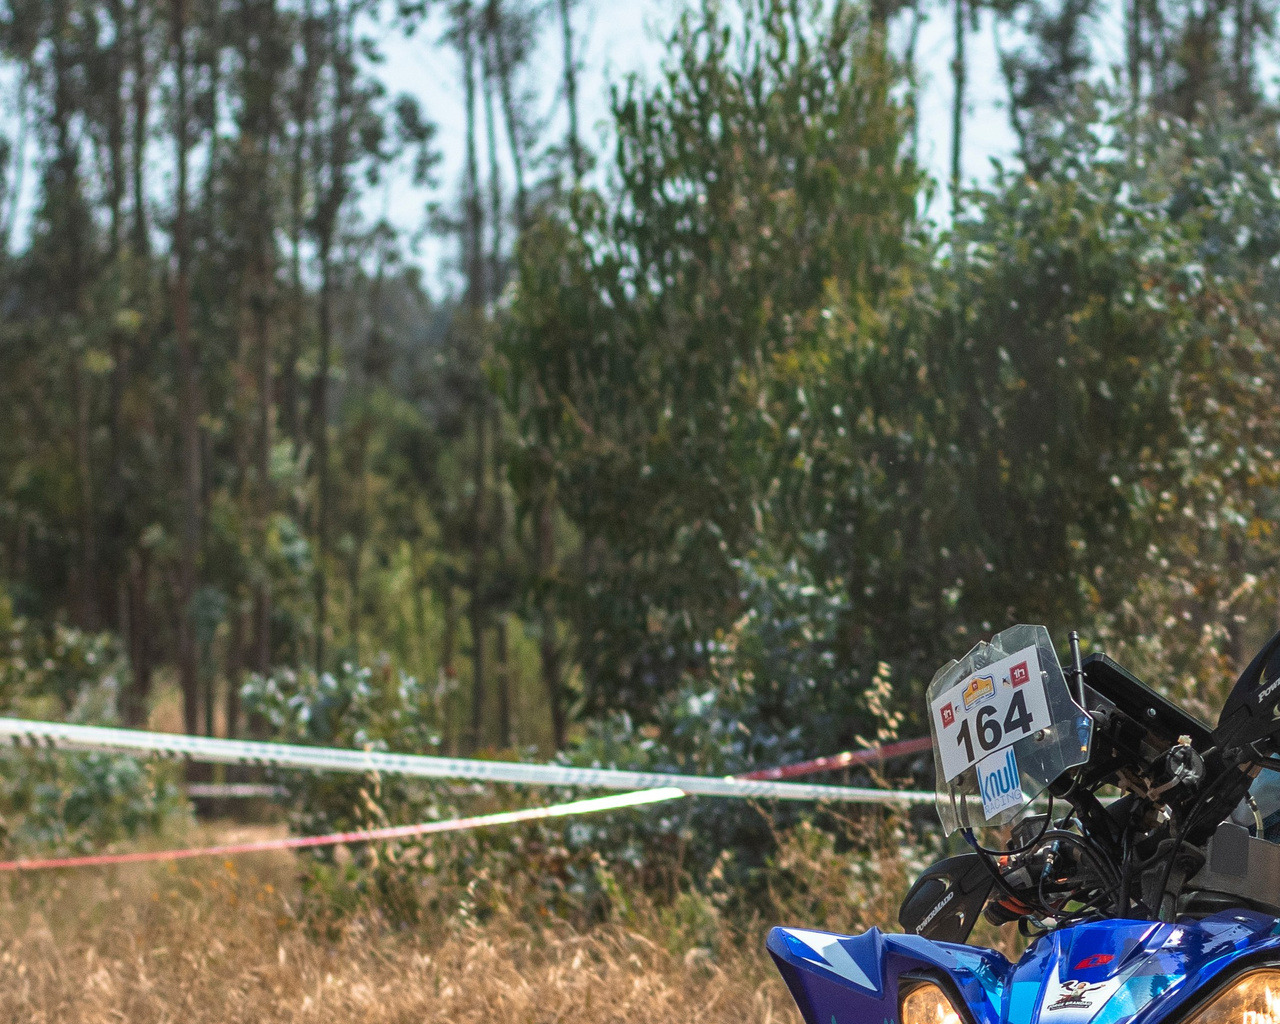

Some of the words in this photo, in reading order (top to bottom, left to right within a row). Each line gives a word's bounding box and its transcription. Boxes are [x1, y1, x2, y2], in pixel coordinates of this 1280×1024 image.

[956, 689, 1033, 763] 164
[977, 749, 1020, 804] knull
[985, 789, 1022, 815] RACING
